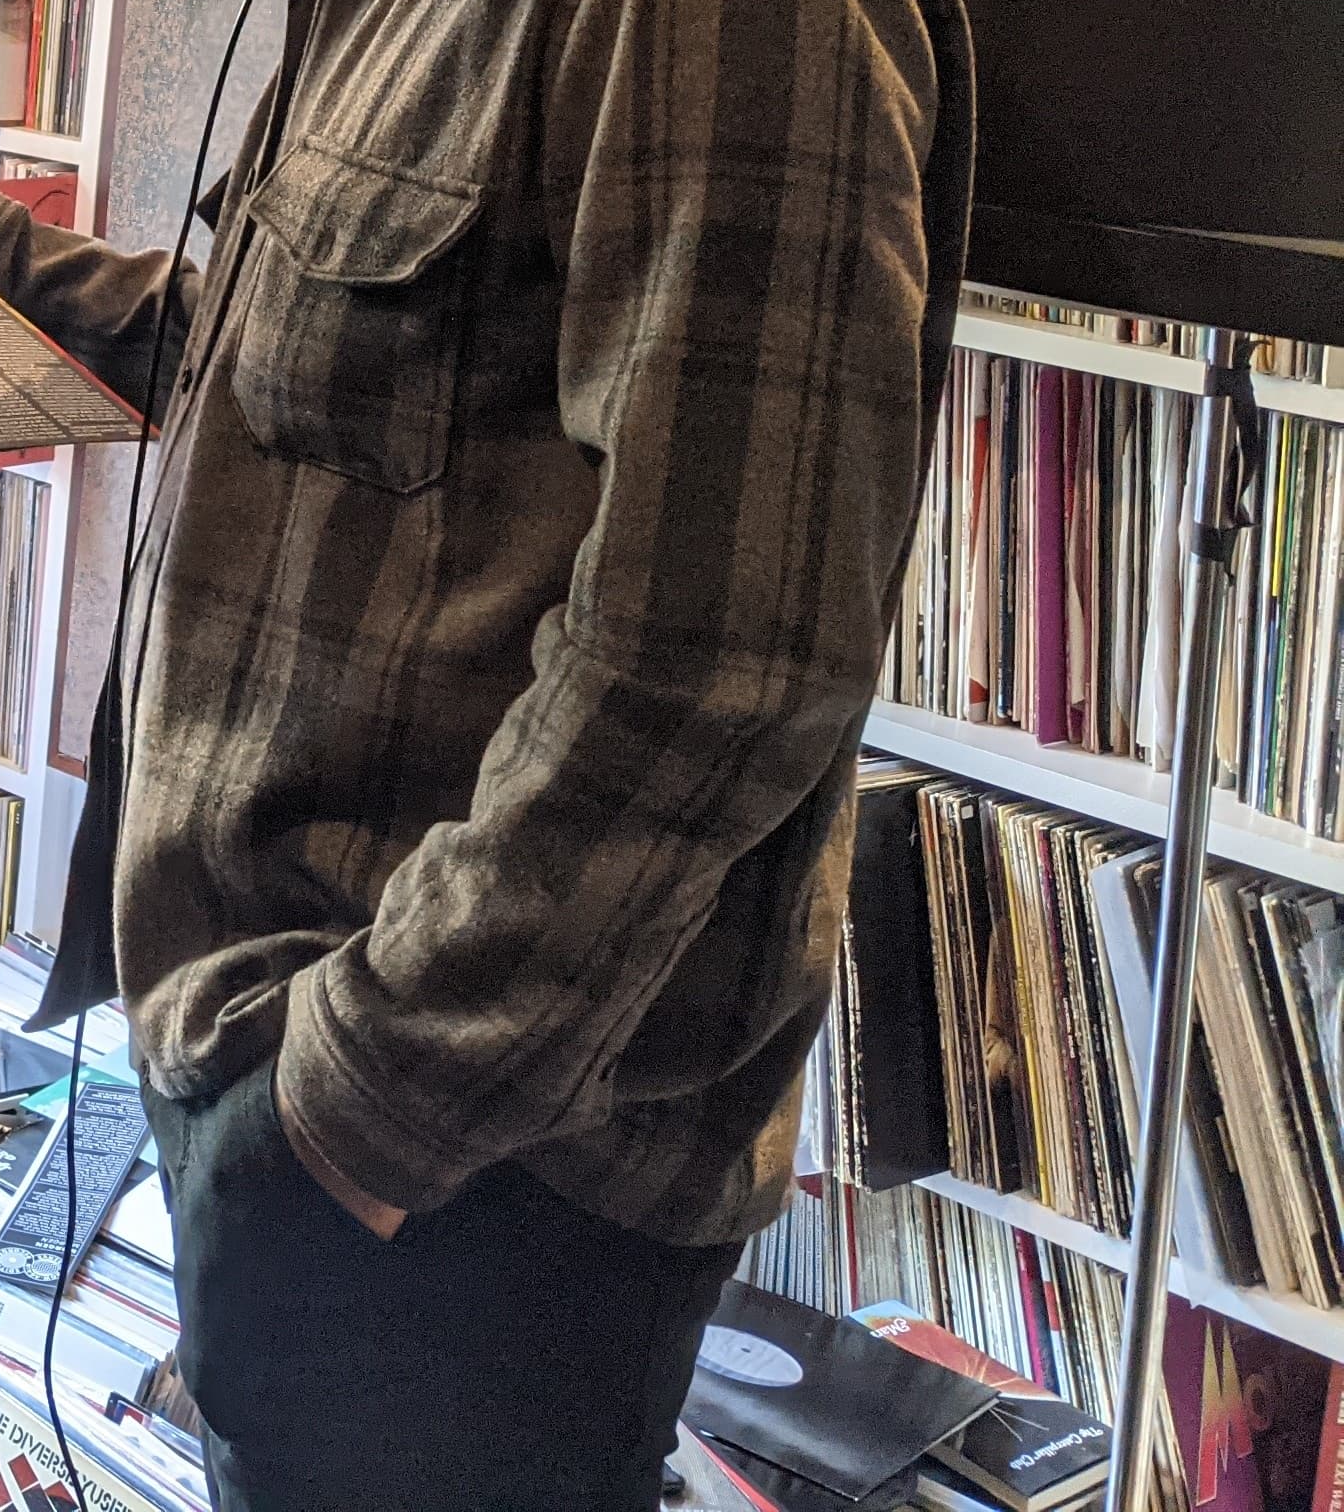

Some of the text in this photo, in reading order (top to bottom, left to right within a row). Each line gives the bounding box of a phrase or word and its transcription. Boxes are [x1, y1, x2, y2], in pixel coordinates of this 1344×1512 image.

[9, 1423, 80, 1488] DIVERS
[1009, 1426, 1104, 1470] The Caterpillar Club
